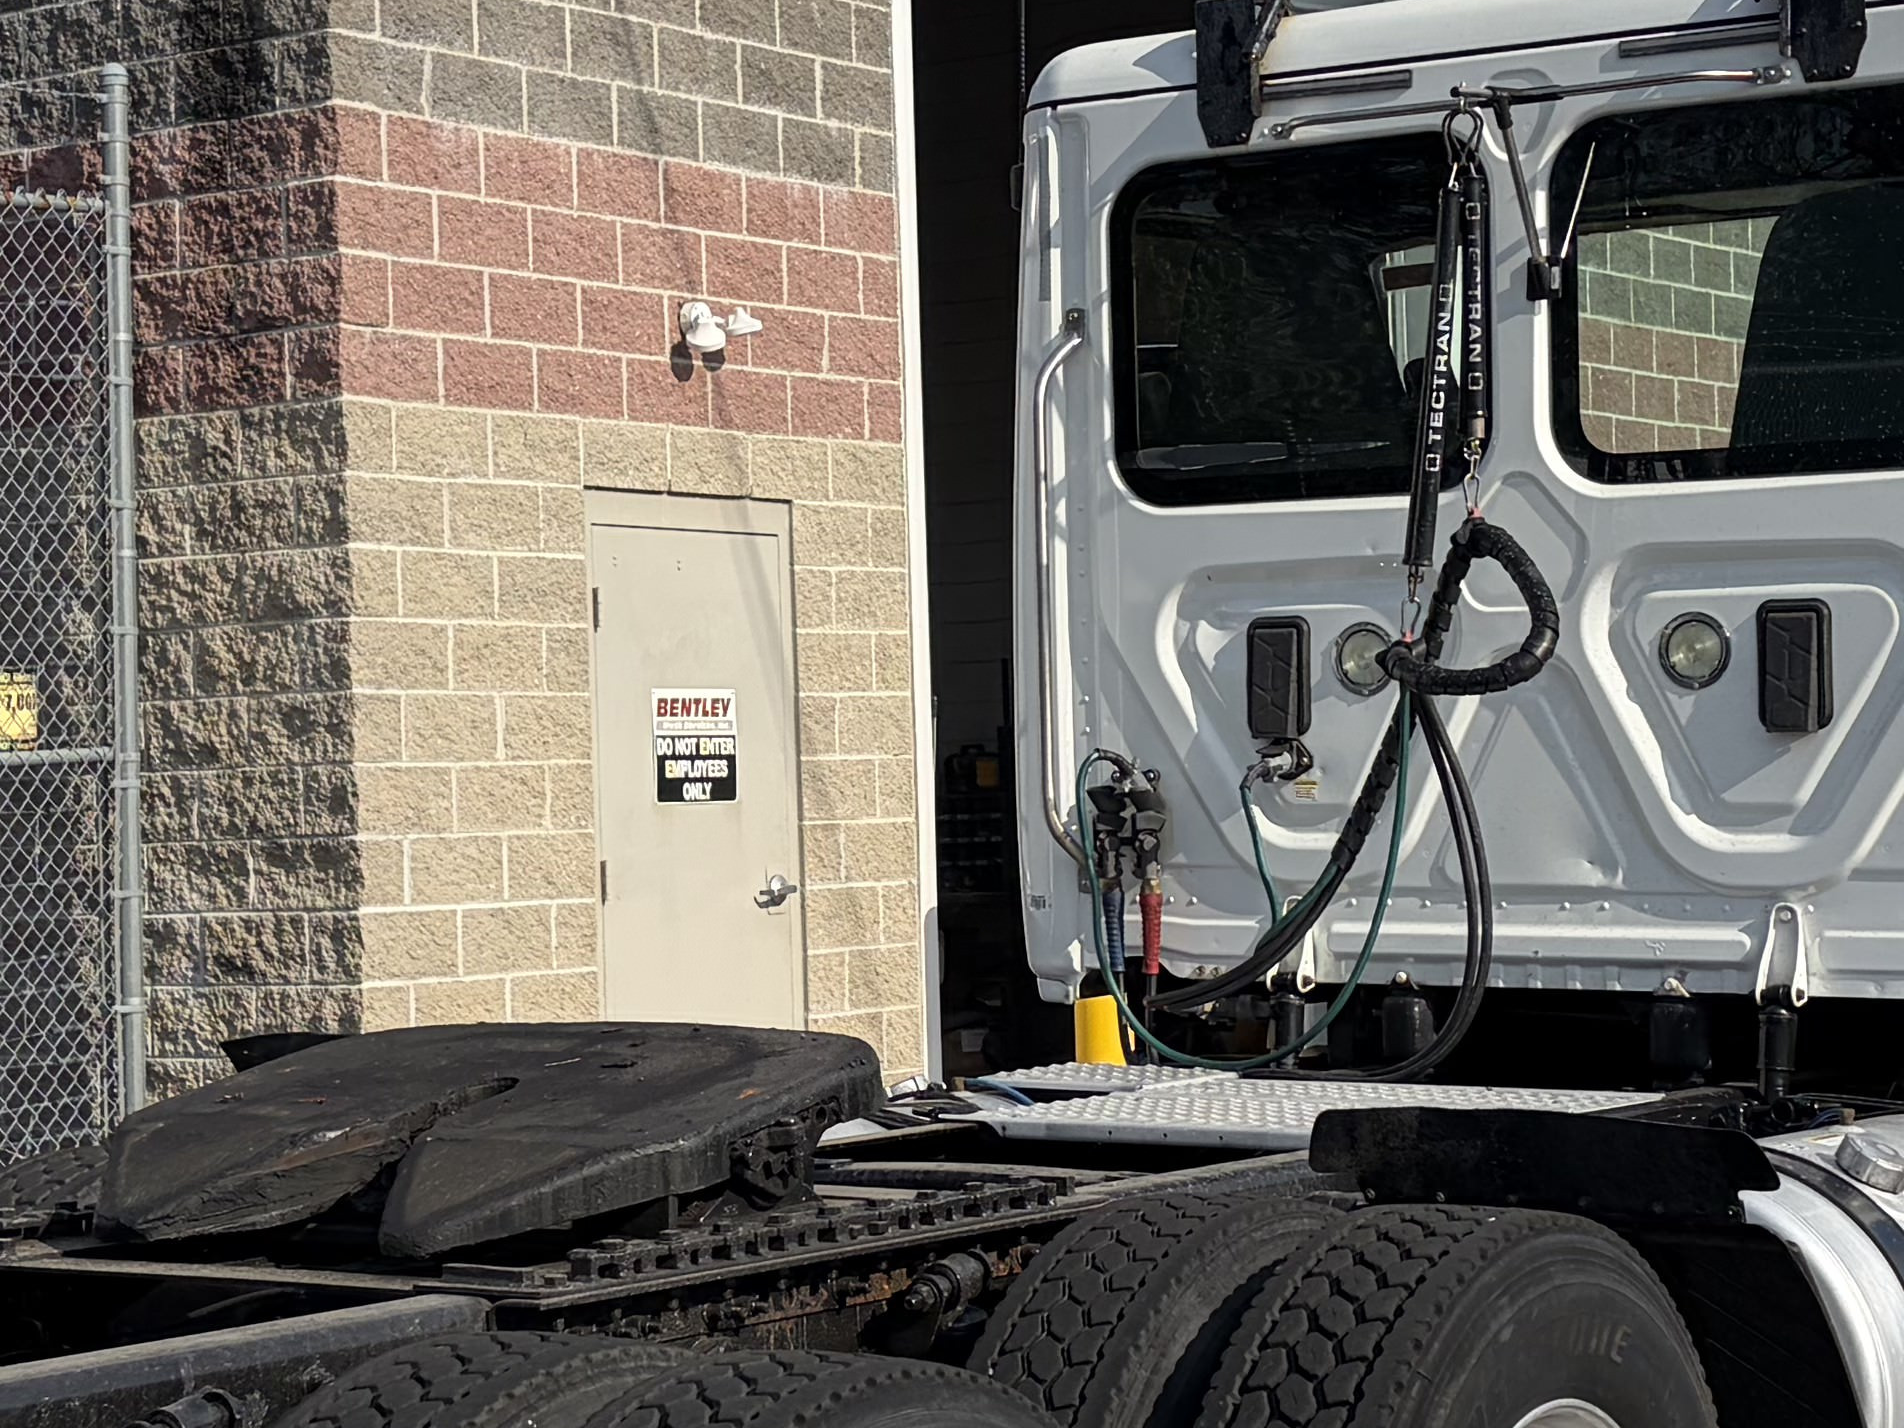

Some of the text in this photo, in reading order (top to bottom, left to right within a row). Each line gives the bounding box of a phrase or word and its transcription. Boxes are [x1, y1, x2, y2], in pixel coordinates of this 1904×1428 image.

[1428, 311, 1451, 446] TECTRAN
[656, 697, 732, 718] BENTLEY
[656, 737, 735, 755] DO NOT ENTER
[664, 759, 729, 778] EMPLOYEES
[682, 781, 712, 801] ONLY
